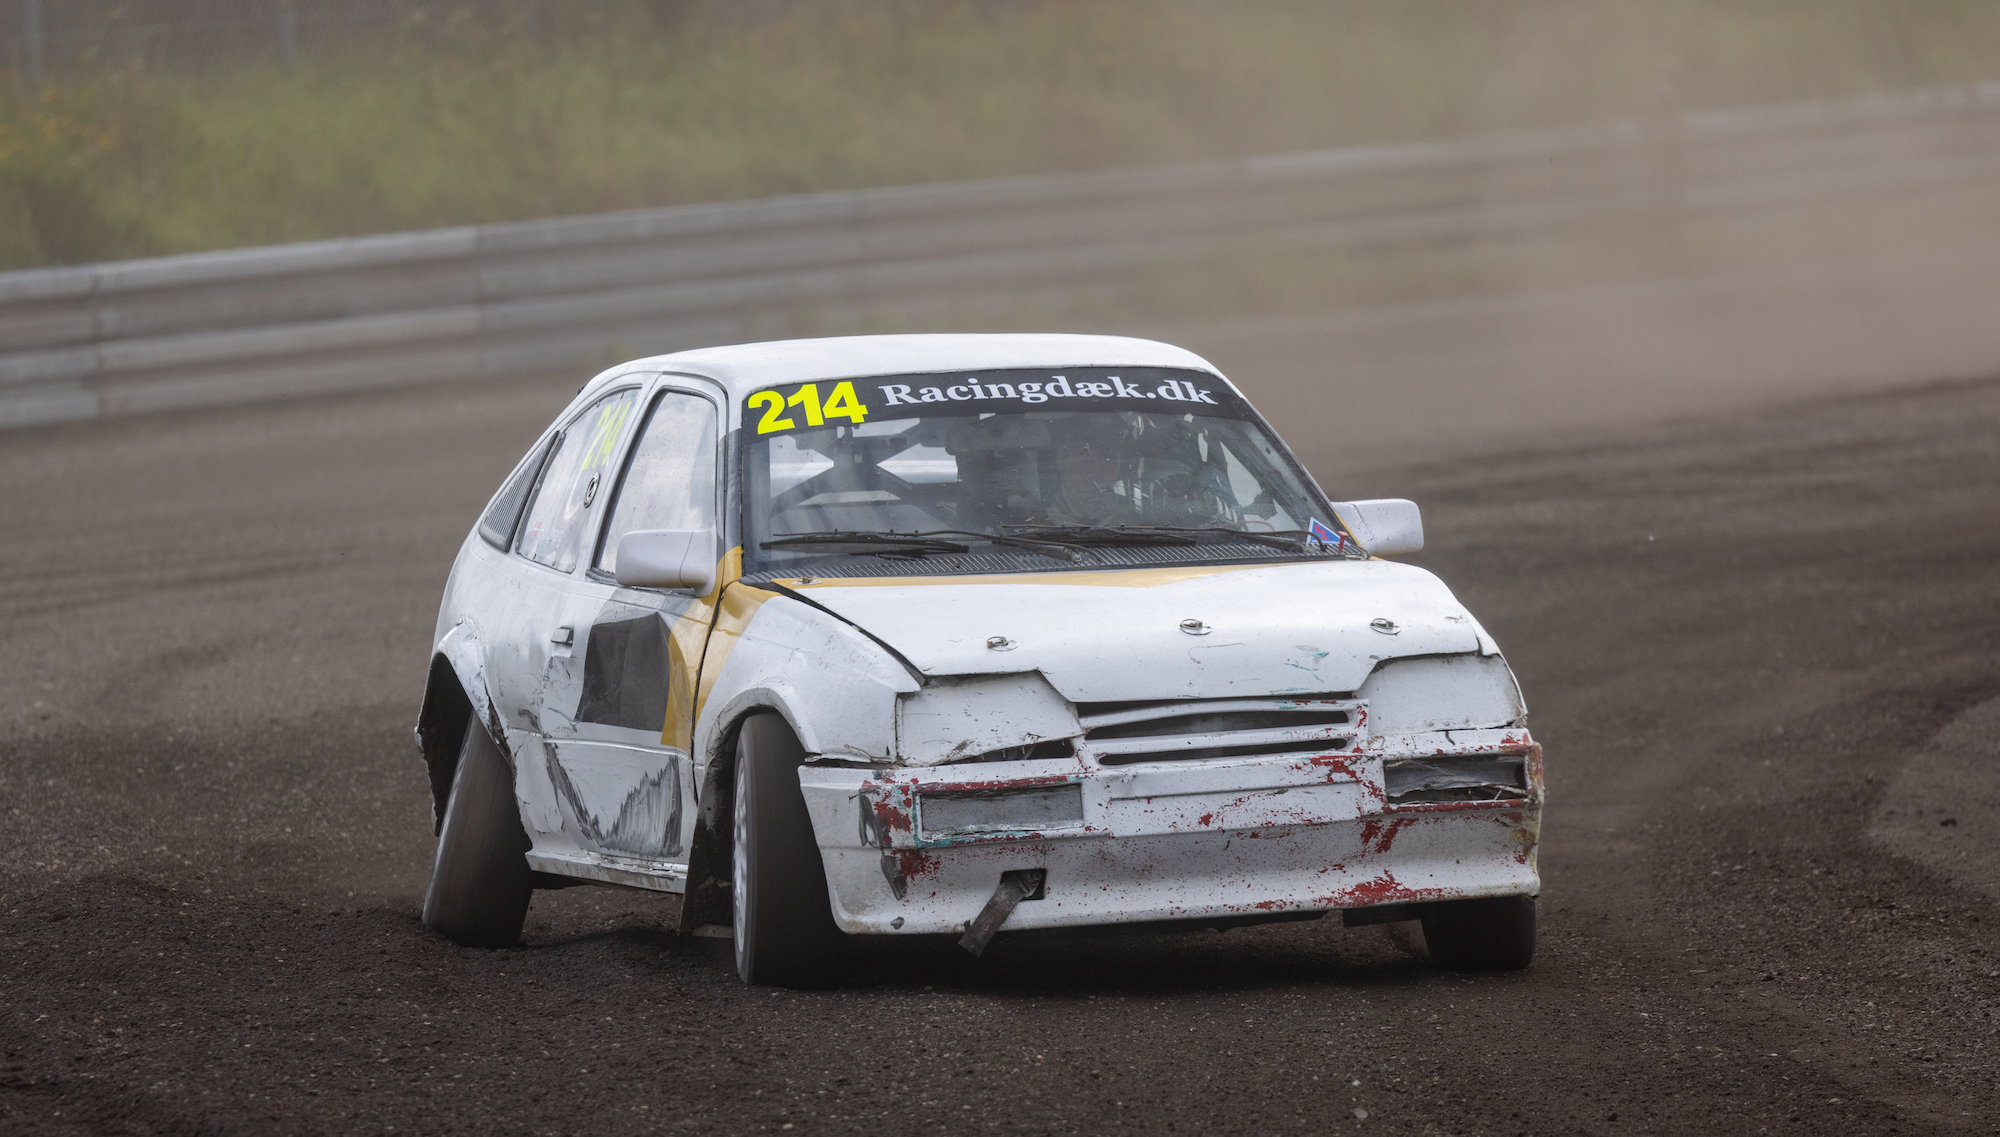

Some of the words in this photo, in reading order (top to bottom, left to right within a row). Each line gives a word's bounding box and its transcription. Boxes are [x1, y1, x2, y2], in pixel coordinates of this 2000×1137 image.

[580, 401, 632, 471] 214
[747, 380, 868, 435] 214
[878, 376, 1218, 405] Racingdæk.dk
